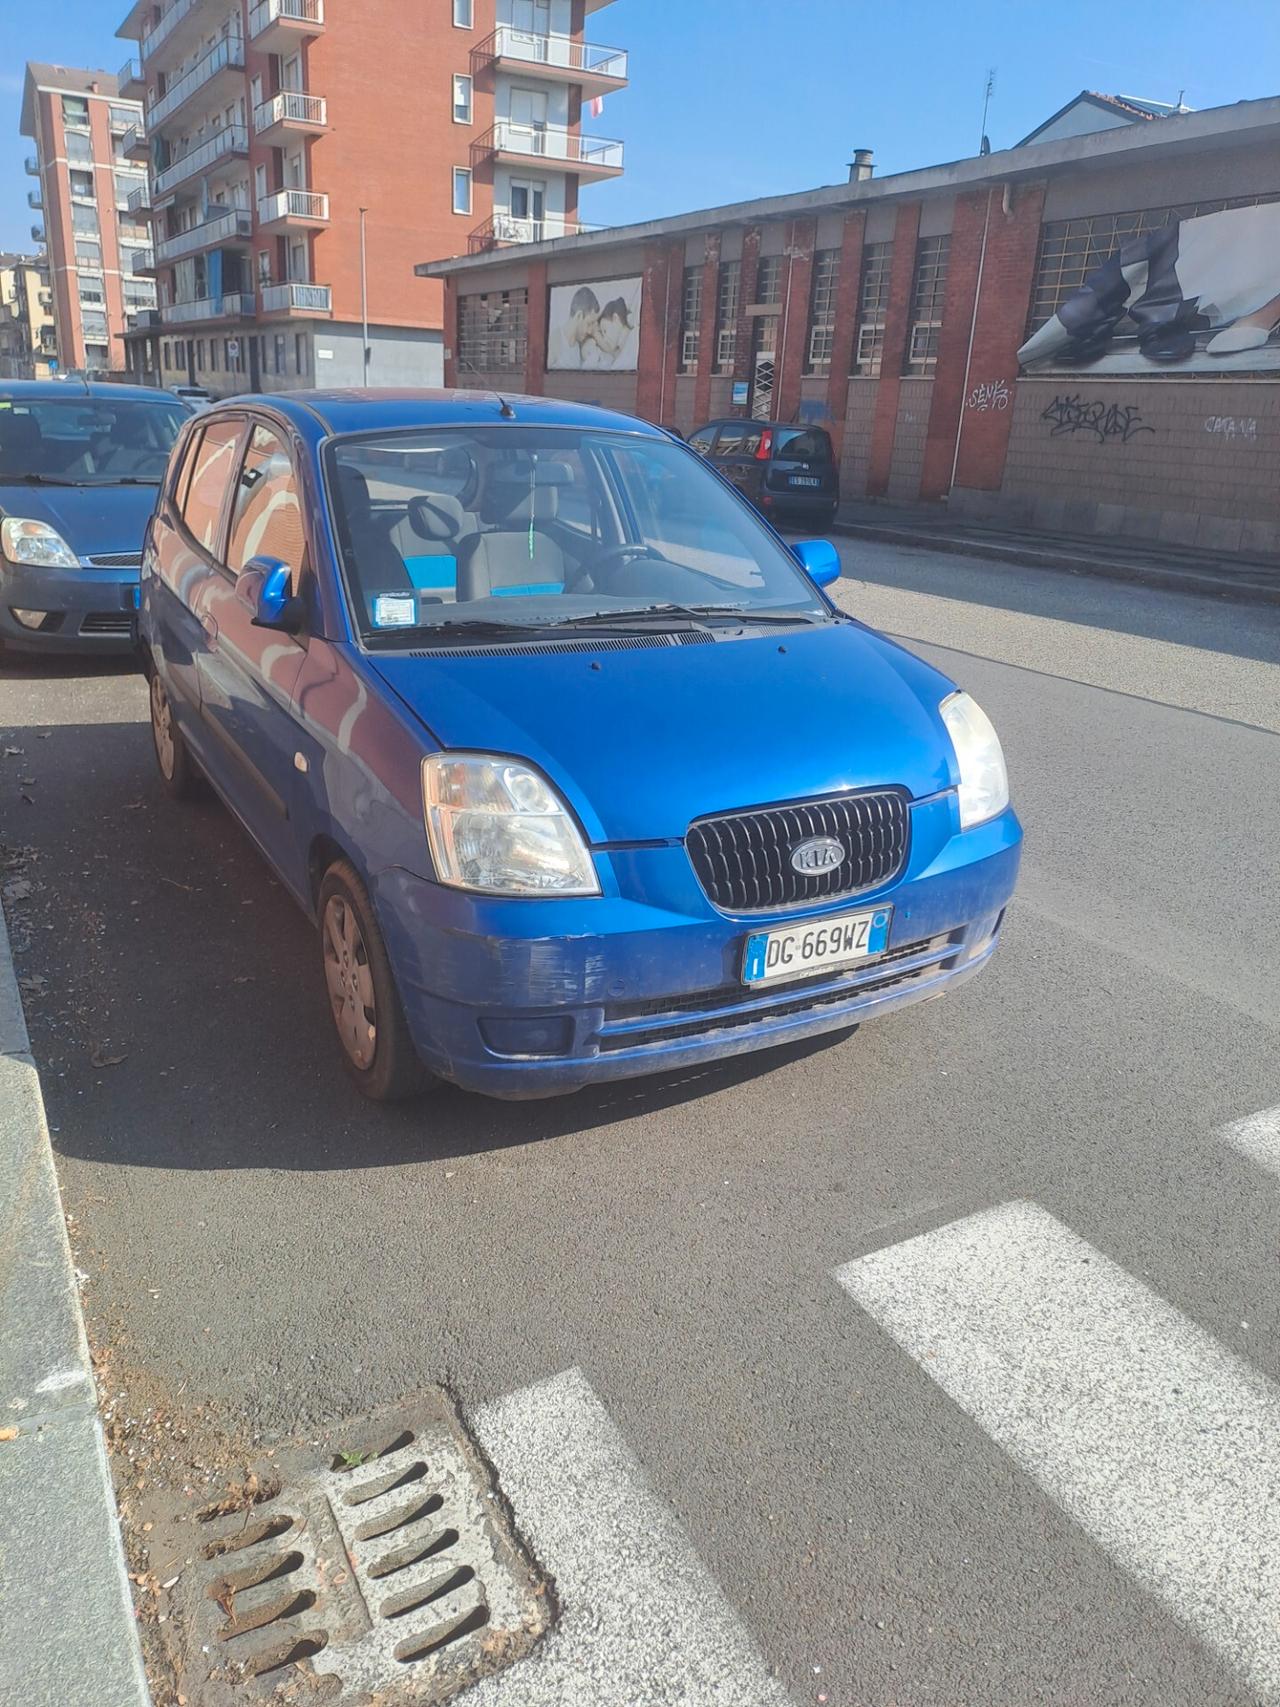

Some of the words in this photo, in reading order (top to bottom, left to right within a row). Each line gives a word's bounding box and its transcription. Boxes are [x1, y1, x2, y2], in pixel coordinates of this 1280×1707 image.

[799, 847, 836, 869] KIA
[766, 936, 795, 969] DG
[802, 920, 870, 959] 669WZ
